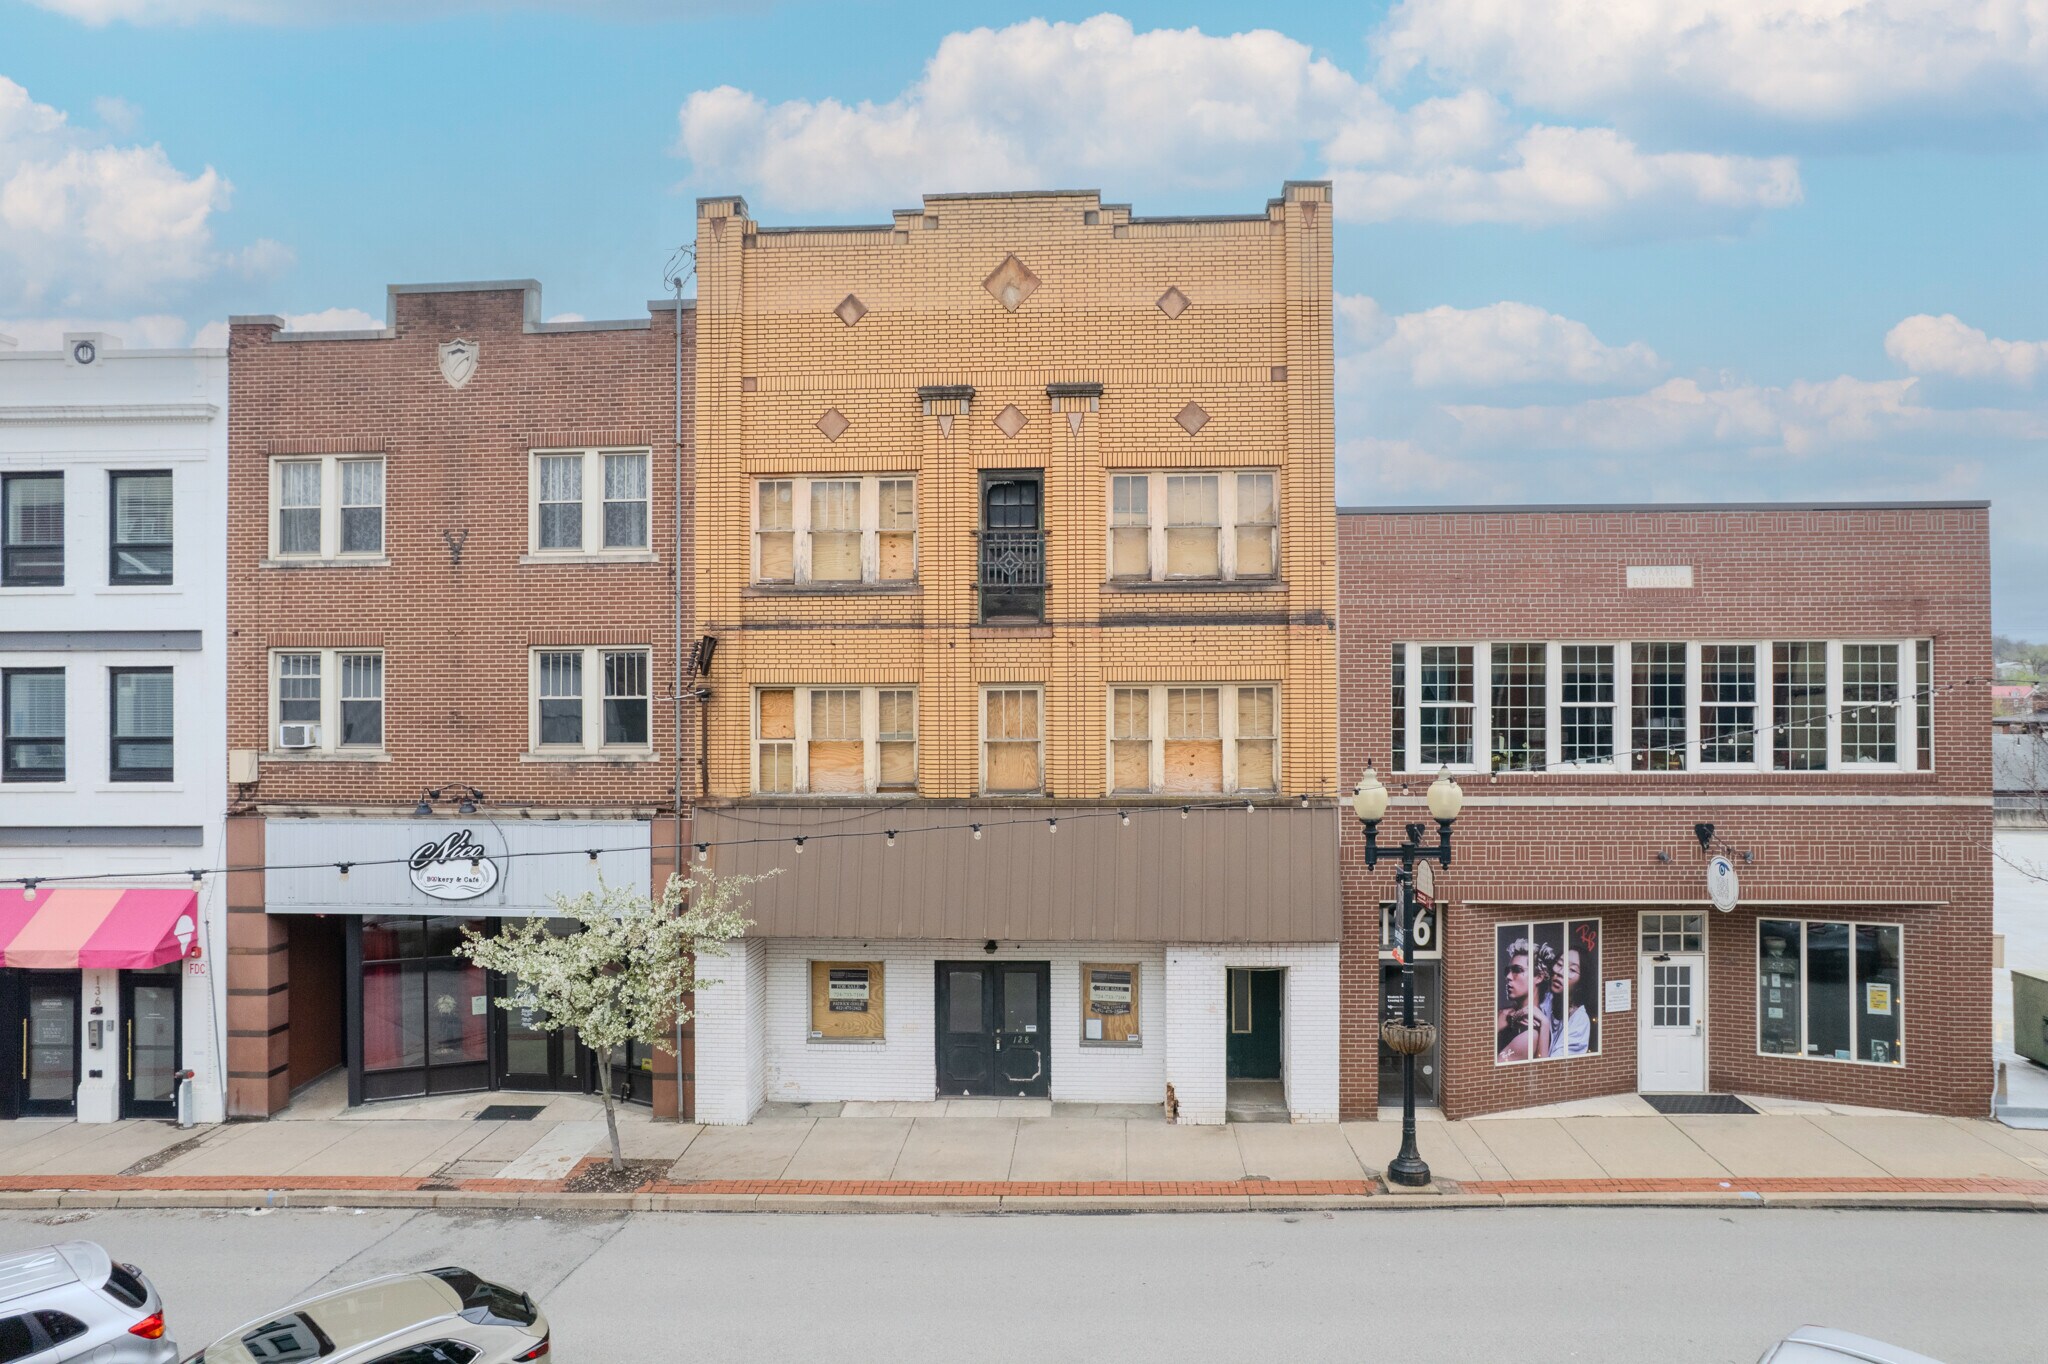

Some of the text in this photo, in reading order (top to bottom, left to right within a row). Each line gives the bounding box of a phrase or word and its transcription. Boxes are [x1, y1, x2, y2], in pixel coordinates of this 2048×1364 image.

[1641, 567, 1677, 577] SARAH
[1633, 577, 1686, 586] BUILDING
[409, 829, 485, 870] Nico
[1382, 907, 1431, 946] 16
[189, 963, 206, 974] FDC
[1013, 1036, 1030, 1044] 128
